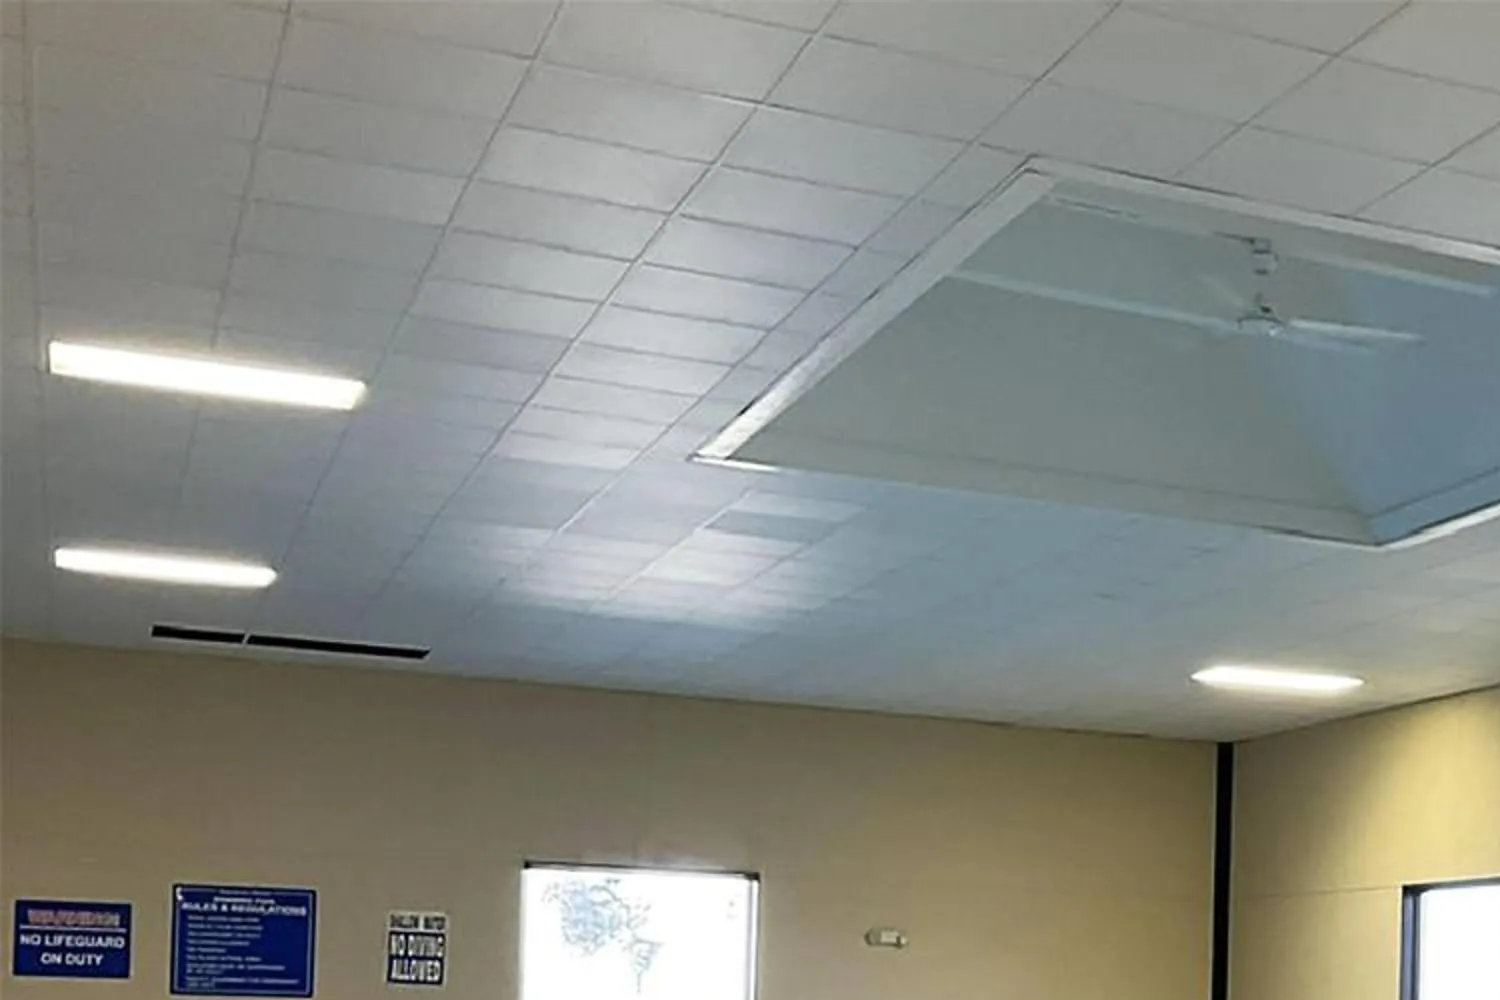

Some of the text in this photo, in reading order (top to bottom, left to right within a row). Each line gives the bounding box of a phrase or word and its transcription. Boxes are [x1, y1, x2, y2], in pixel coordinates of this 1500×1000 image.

[20, 934, 125, 948] NO LIFEGUARD
[391, 934, 443, 957] NO DIVING
[40, 952, 104, 966] ON DUTY
[391, 959, 441, 981] ALLOWED
